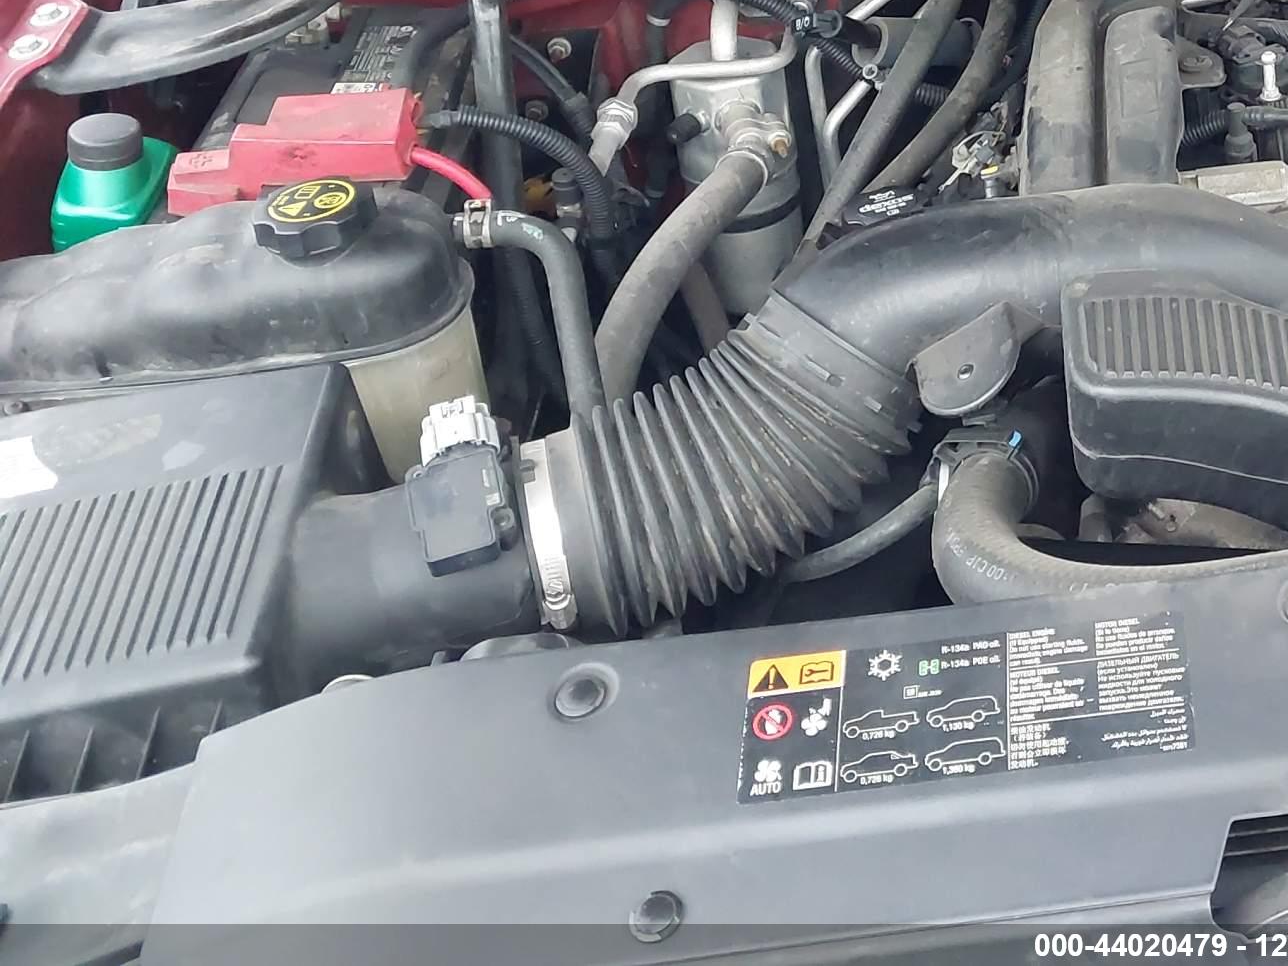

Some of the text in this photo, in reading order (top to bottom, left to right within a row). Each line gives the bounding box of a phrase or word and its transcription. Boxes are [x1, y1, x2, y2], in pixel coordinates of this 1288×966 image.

[941, 644, 970, 654] R-134a
[941, 658, 970, 669] R-134a
[750, 781, 782, 796] AUTO
